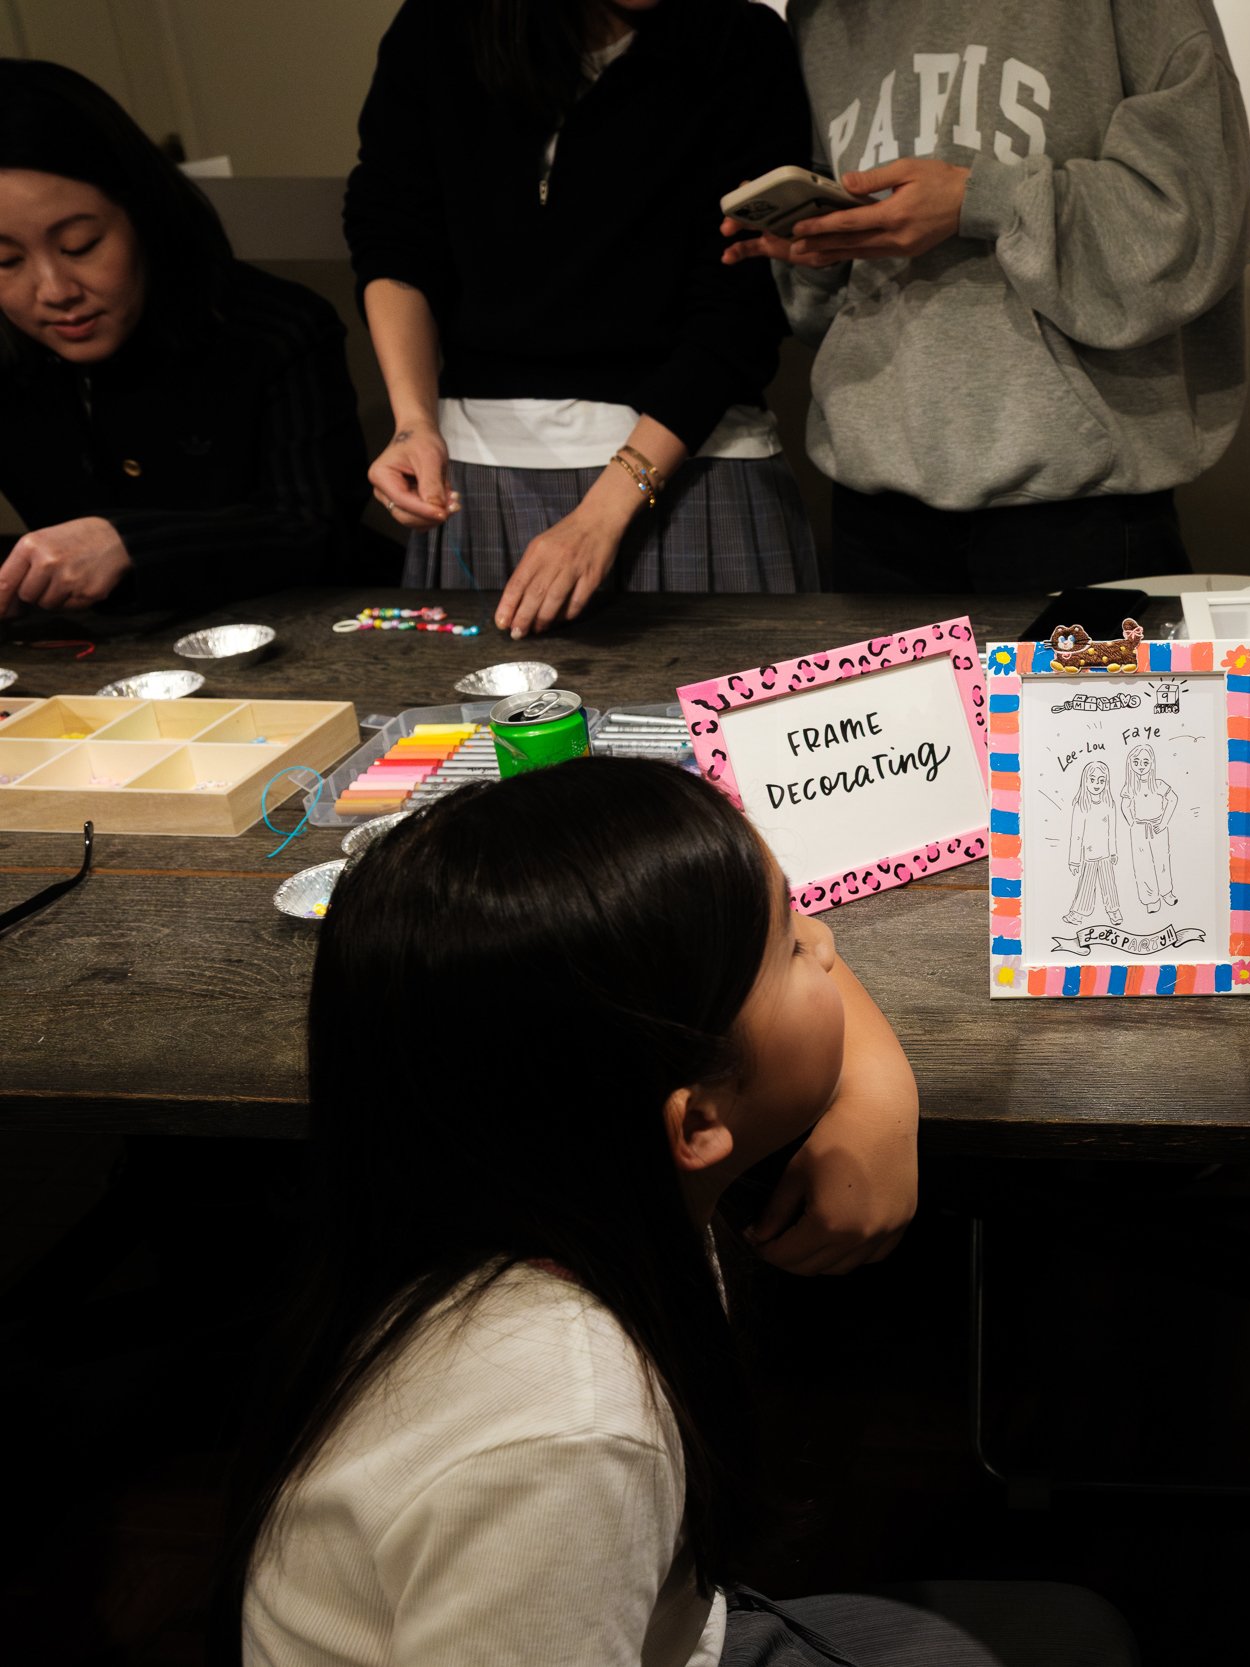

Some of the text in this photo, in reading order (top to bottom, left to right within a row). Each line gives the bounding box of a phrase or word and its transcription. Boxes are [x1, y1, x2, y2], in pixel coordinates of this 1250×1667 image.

[829, 44, 1051, 190] PARIS
[1057, 742, 1106, 772] Lee-Lou
[1084, 928, 1120, 946] Let's
